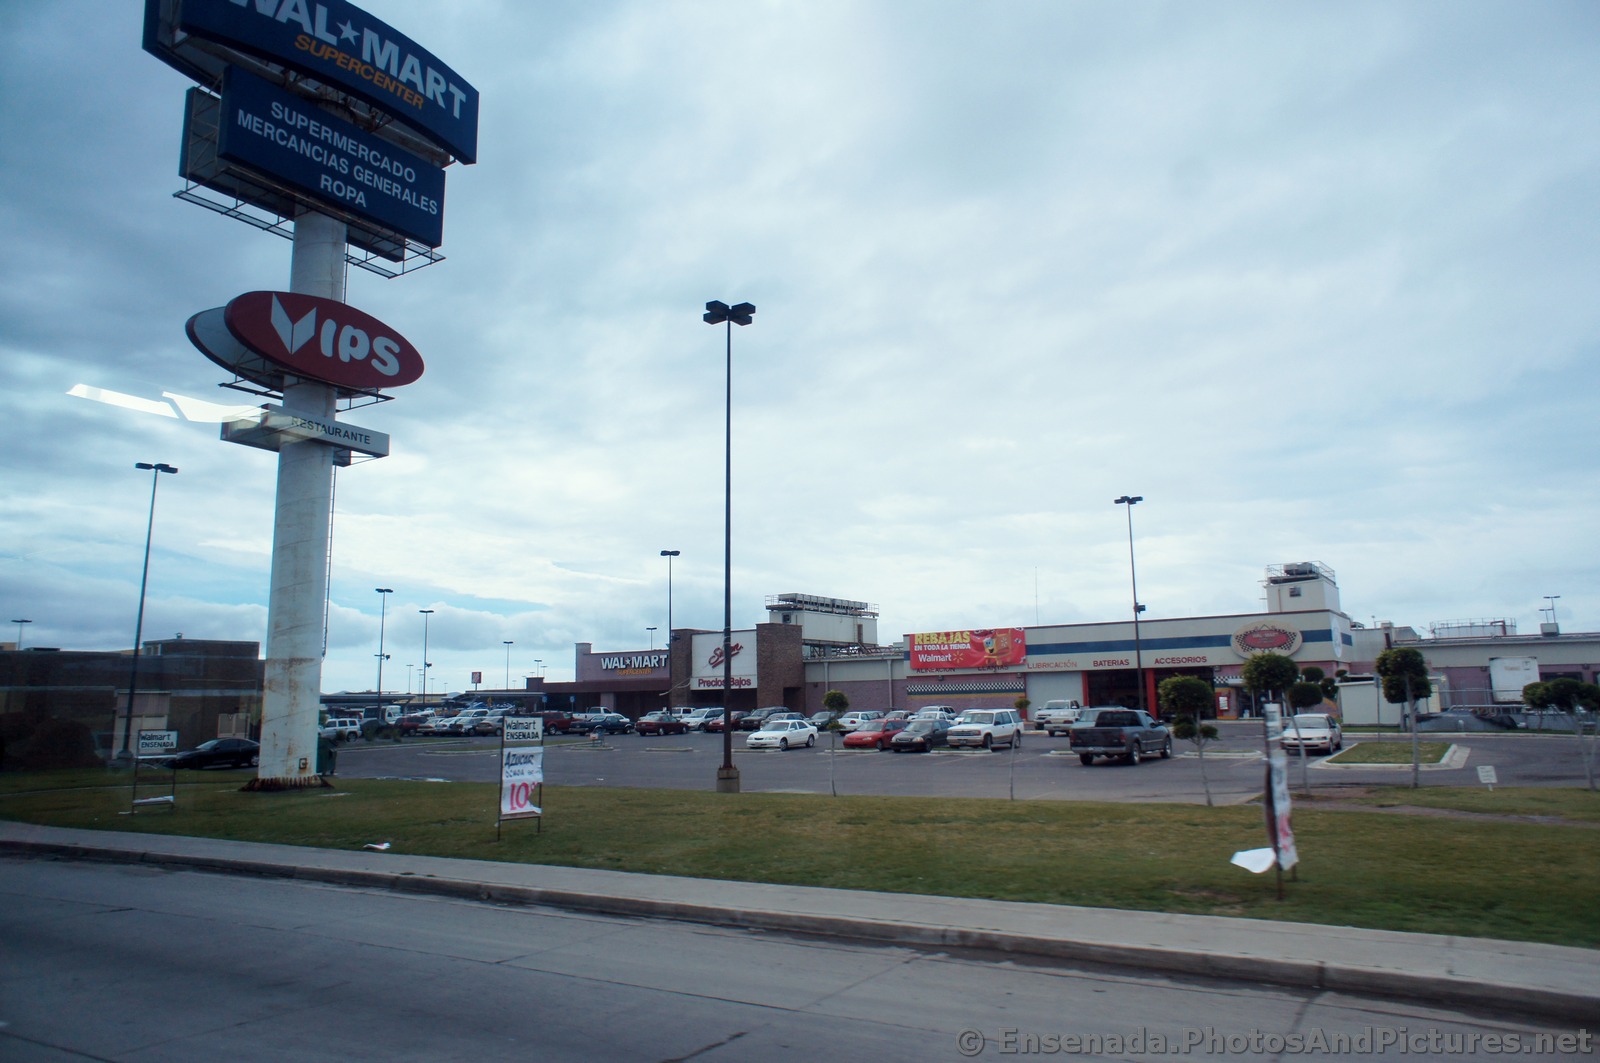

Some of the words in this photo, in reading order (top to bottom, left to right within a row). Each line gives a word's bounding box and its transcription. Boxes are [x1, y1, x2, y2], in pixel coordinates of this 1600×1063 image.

[294, 33, 425, 111] SUPERCENTER
[361, 27, 467, 120] MART
[270, 101, 416, 184] SUPERMERCADO
[237, 108, 349, 176] MERCANCIAS
[353, 164, 439, 216] GENERALES
[319, 173, 368, 209] ROPA
[291, 416, 371, 445] RESTAURANTE
[914, 631, 971, 644] REBAJAS
[918, 654, 952, 663] Walmart
[1027, 659, 1078, 670] LUBRICACIÓN
[1093, 659, 1130, 668] BATERIAS
[1154, 655, 1207, 665] ACCESORIOS
[505, 719, 536, 730] Walmart
[505, 731, 540, 740] ENSENADA
[140, 733, 171, 741] Walmart
